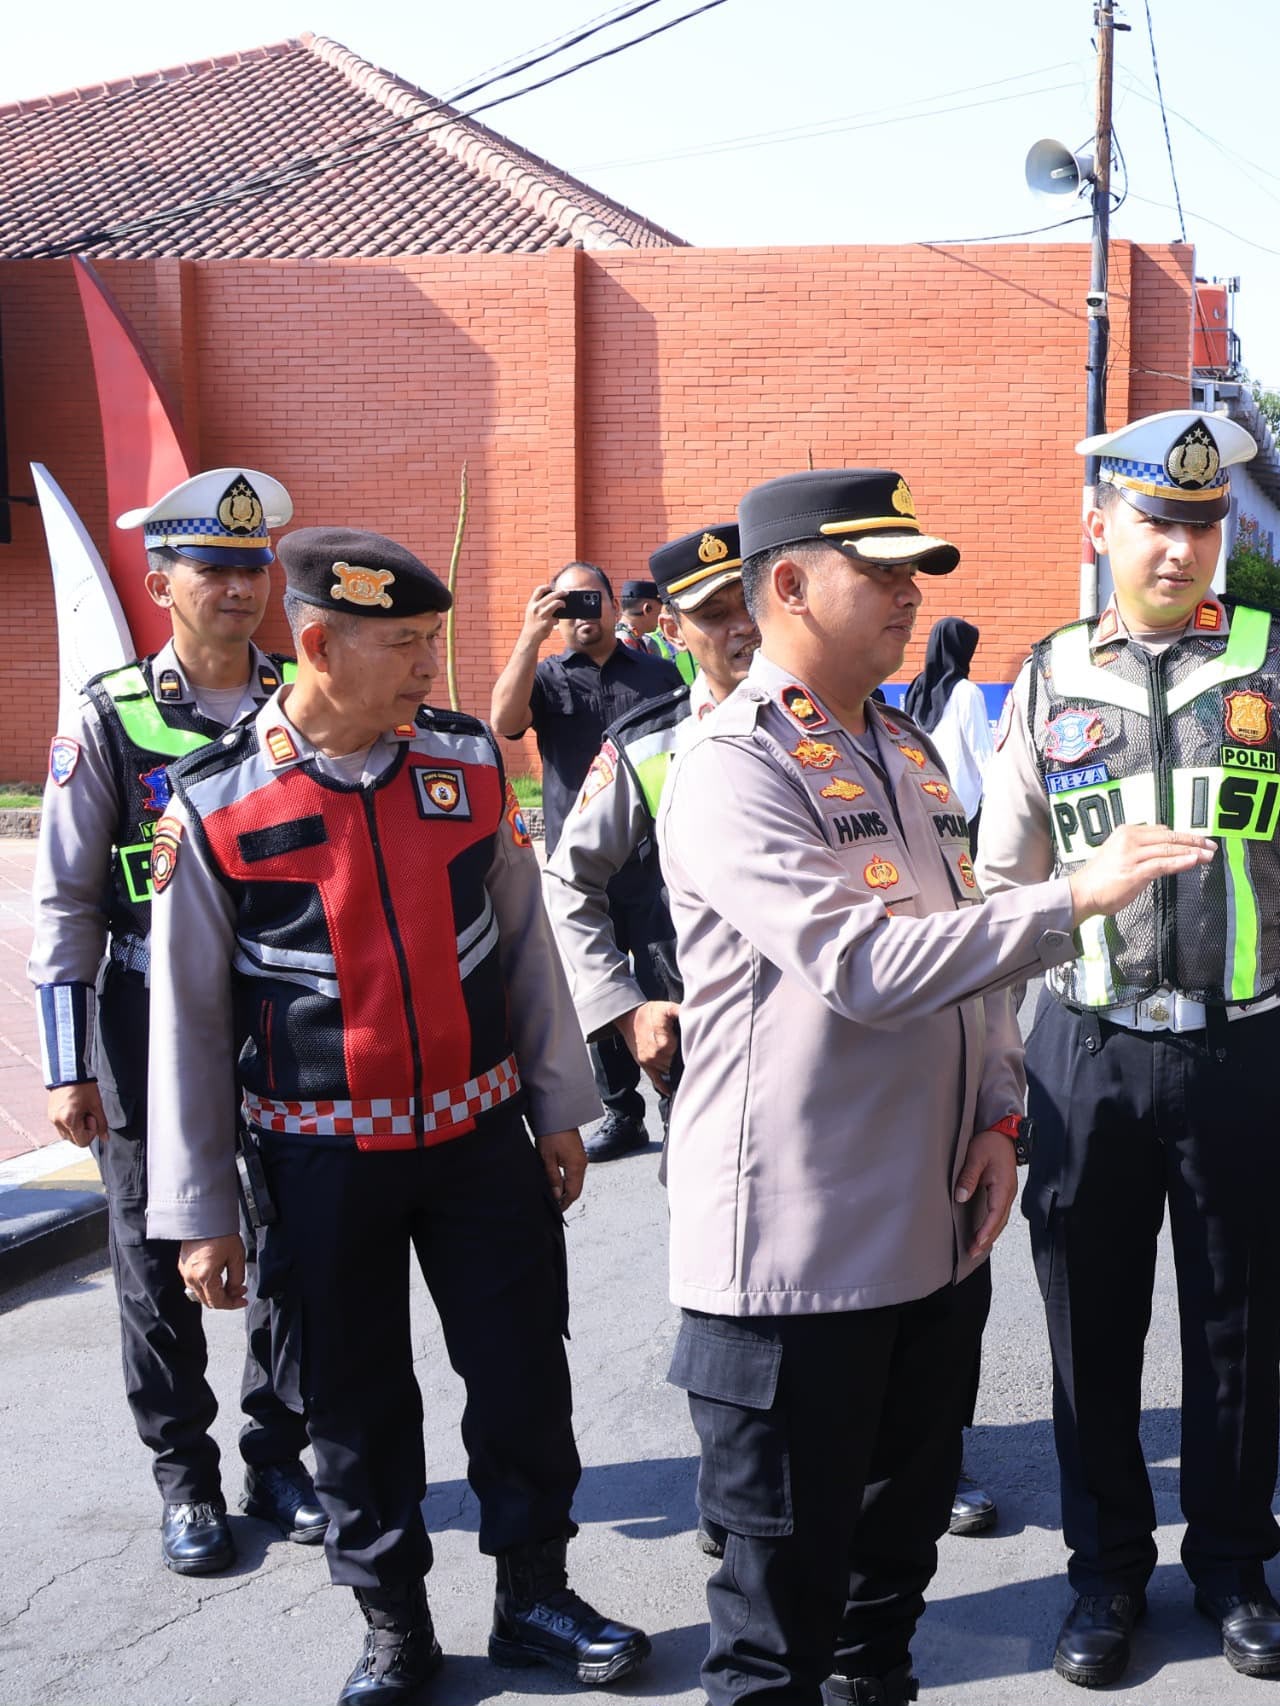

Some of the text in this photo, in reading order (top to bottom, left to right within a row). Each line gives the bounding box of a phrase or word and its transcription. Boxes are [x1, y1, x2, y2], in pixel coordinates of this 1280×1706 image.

[1225, 748, 1274, 769] POLRI
[1052, 768, 1103, 790] REZA
[833, 811, 888, 844] HARIS
